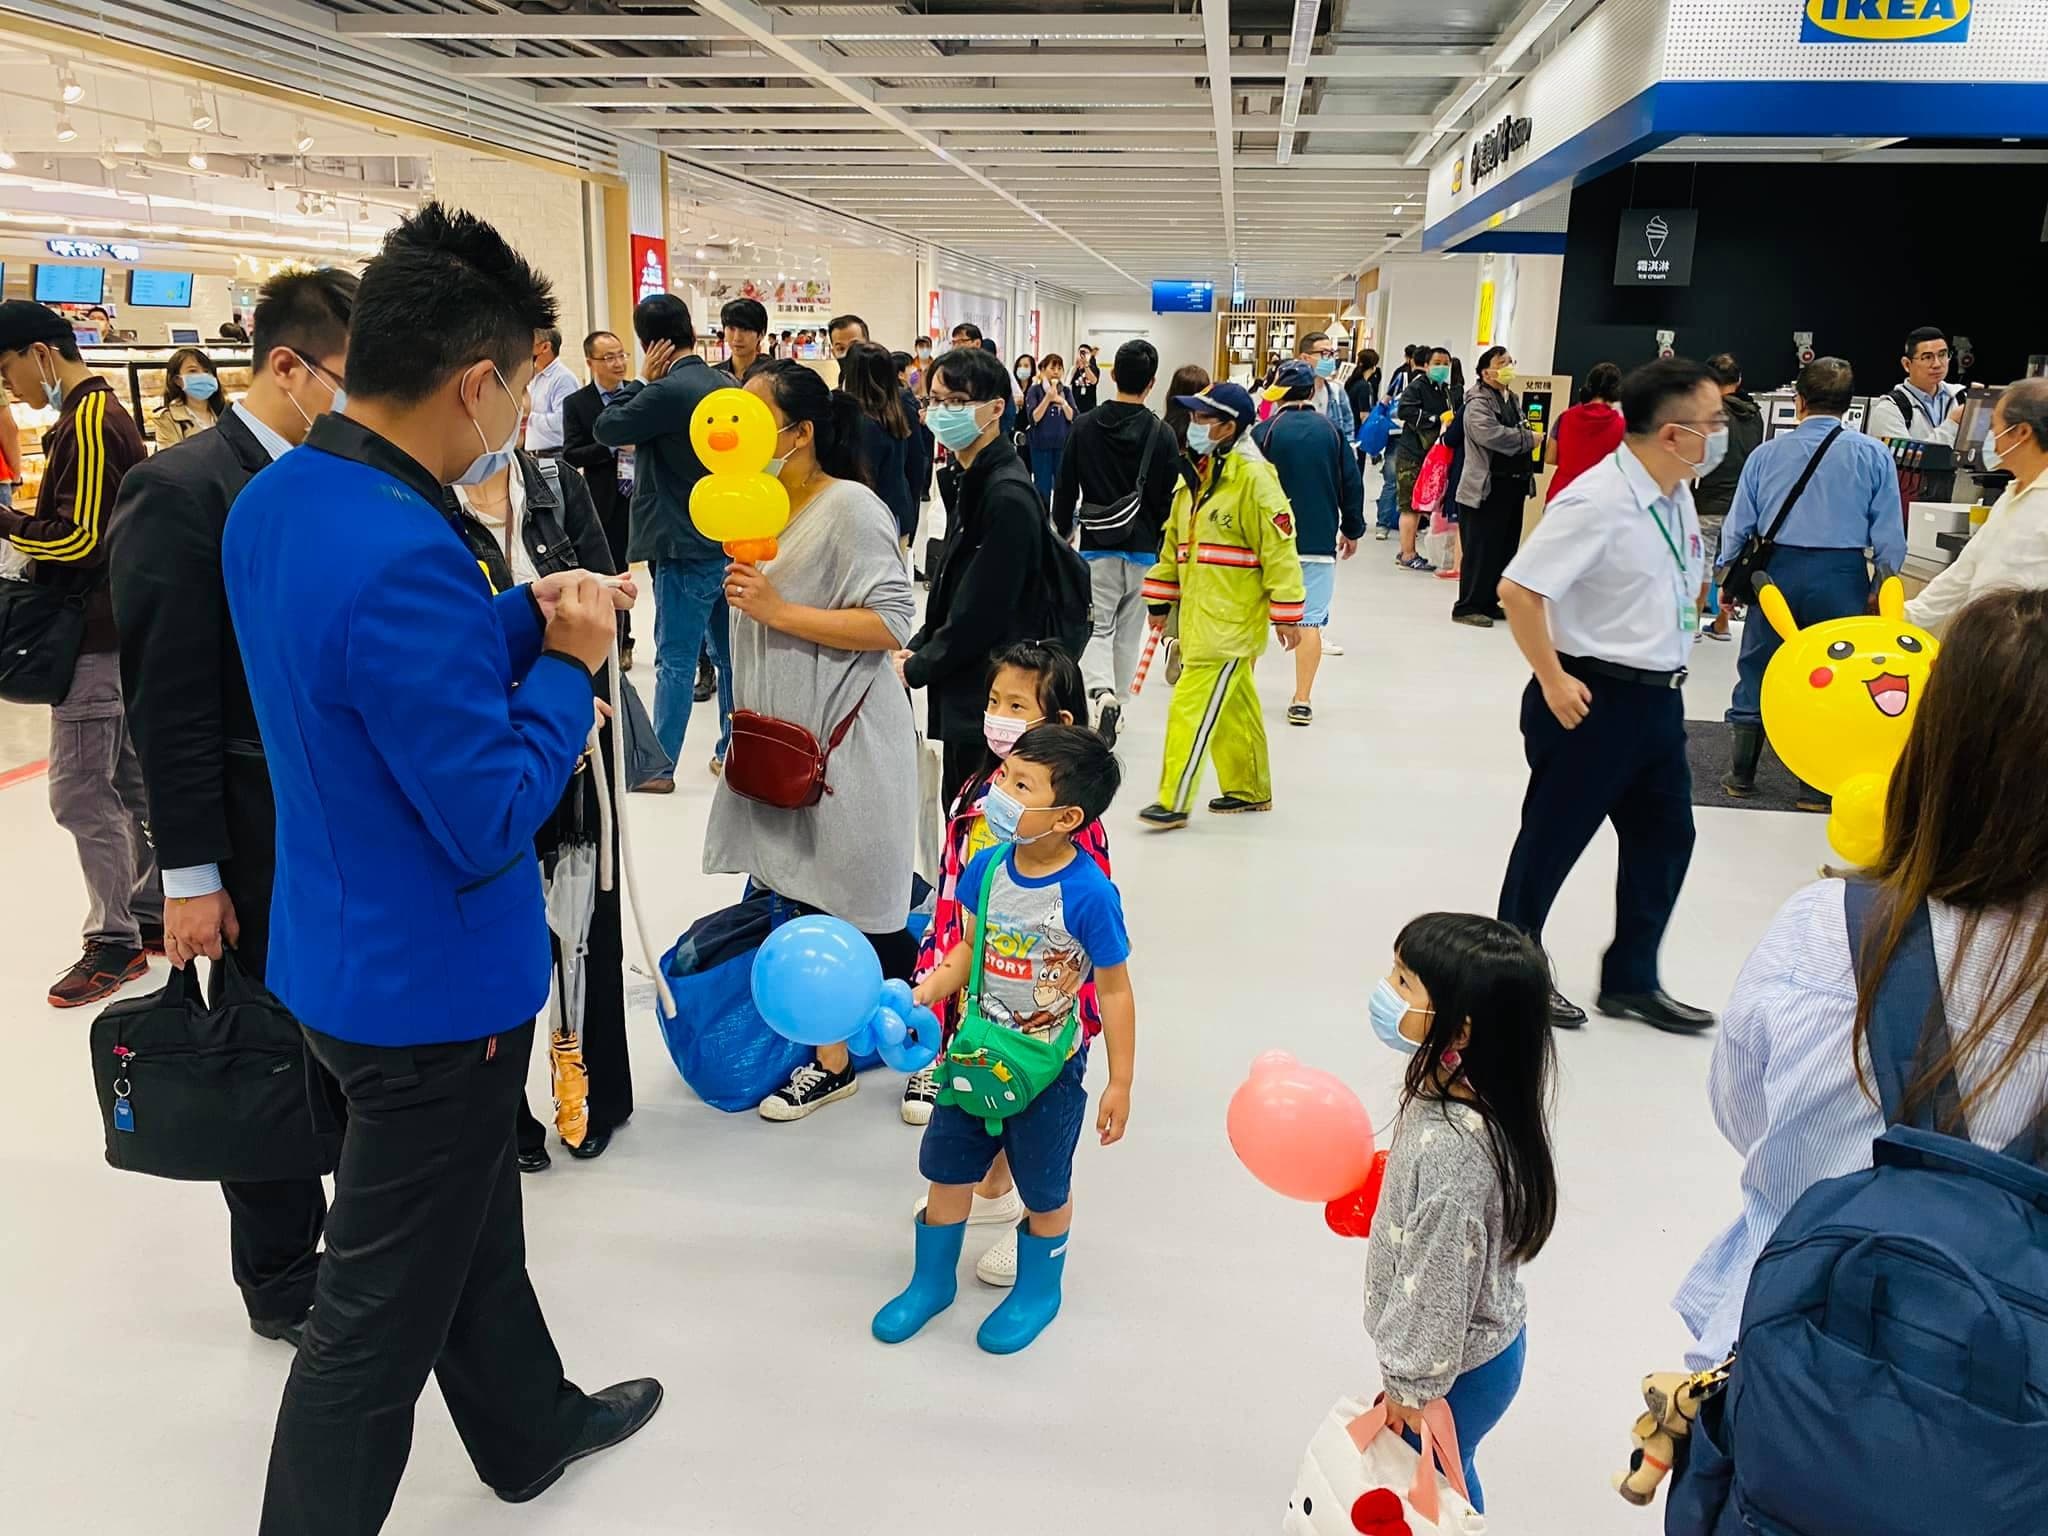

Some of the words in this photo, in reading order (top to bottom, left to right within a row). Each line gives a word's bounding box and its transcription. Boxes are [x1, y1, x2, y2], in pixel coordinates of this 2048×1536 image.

[1821, 0, 1957, 19] IKEA
[1637, 259, 1670, 272] 霜淇淋
[985, 921, 1039, 958] TOY
[985, 952, 1027, 975] STORY
